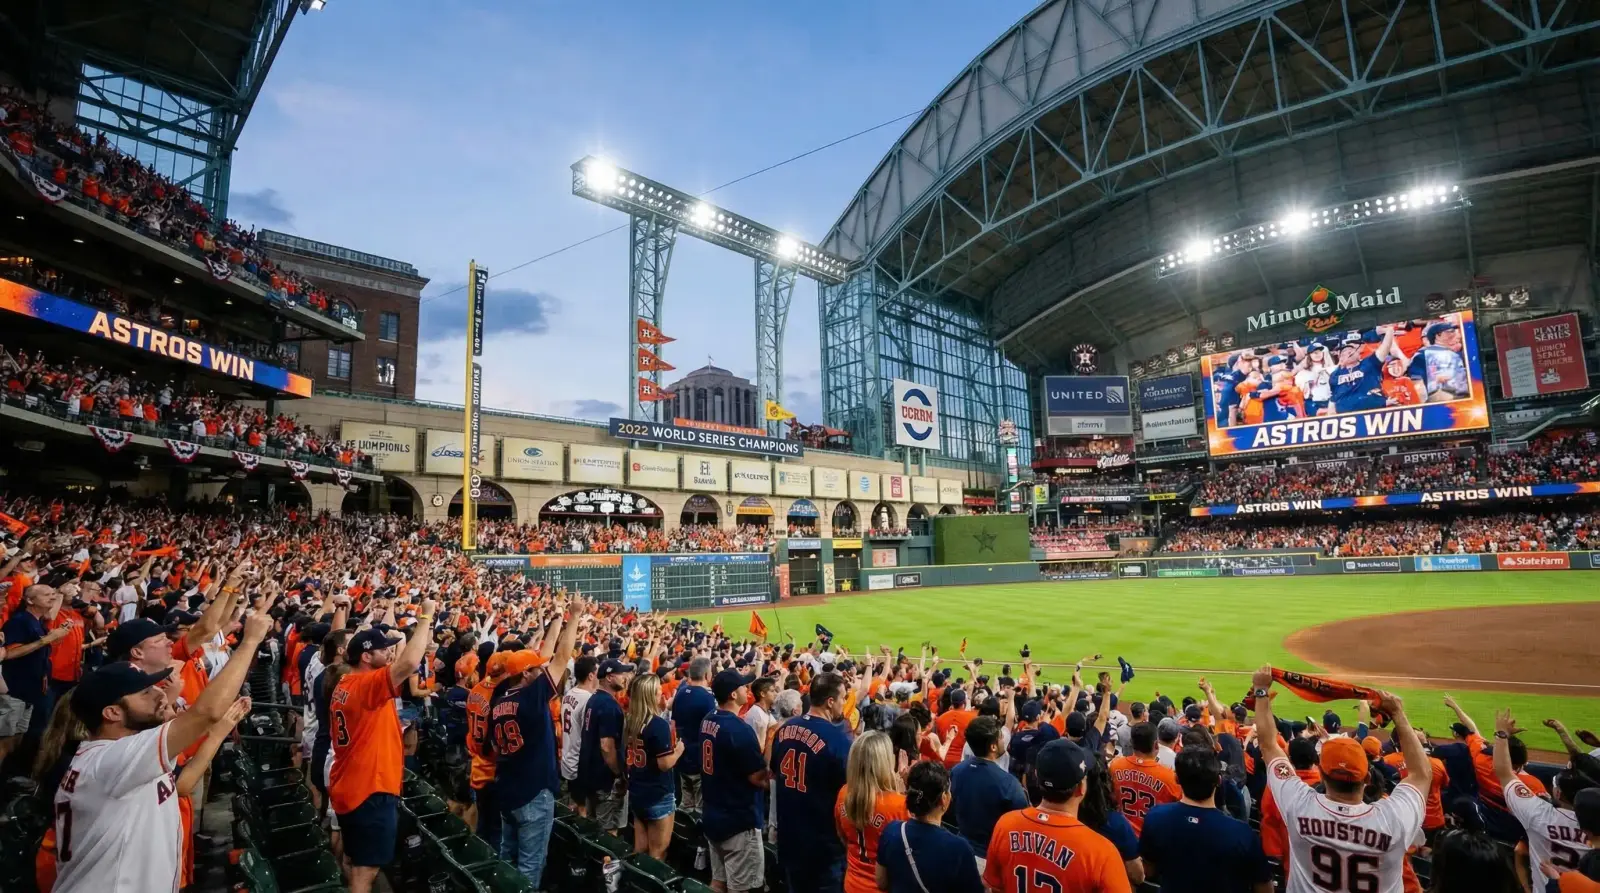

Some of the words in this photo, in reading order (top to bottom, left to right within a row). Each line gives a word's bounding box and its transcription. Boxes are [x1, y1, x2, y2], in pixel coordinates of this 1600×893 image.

[1247, 302, 1330, 332] Minute
[1336, 286, 1402, 312] Maid
[88, 311, 202, 365] ASTROS
[209, 347, 254, 381] WIN
[1051, 391, 1104, 400] UNITED
[618, 423, 649, 436] 2022
[652, 426, 696, 441] WORLD
[699, 433, 736, 446] SERIES
[739, 438, 799, 454] CHAMPIONS
[1252, 417, 1358, 448] ASTROS
[1364, 408, 1424, 437] WIN
[1236, 501, 1290, 514] ASTROS
[1293, 500, 1322, 511] WIN
[1421, 488, 1490, 502] ASTROS
[1494, 486, 1533, 498] WIN
[702, 739, 714, 776] 8
[780, 748, 808, 793] 41
[1120, 785, 1156, 819] 23
[1297, 816, 1393, 853] HOUSTON
[1310, 844, 1381, 893] 96
